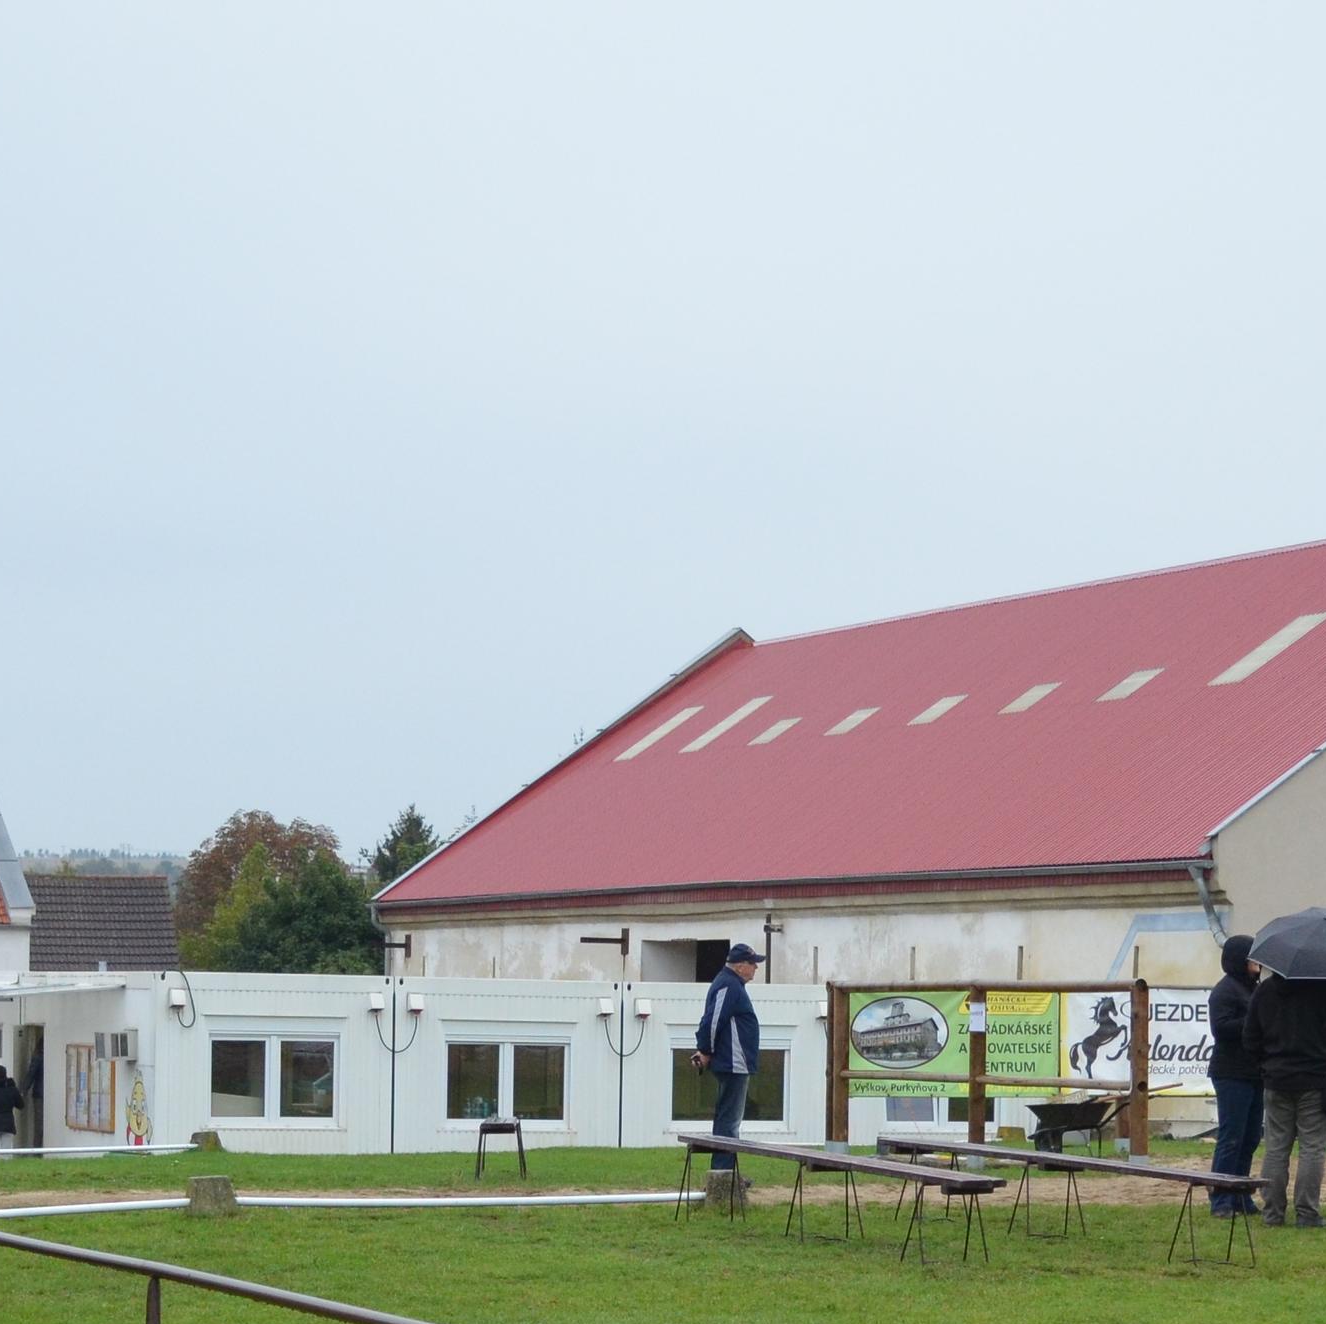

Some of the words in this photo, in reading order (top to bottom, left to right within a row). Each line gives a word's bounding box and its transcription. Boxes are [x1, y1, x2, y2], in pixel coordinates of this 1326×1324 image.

[1148, 1004, 1208, 1022] JEZDE
[958, 1021, 1052, 1035] ZRÁDKÁŘSKÉ
[958, 1043, 968, 1054] A
[988, 1040, 1052, 1054] OVATELSKÉ
[985, 1061, 1036, 1073] ENTRUM
[854, 1082, 890, 1094] Vyškov,
[890, 1083, 939, 1094] Purkyňova
[939, 1083, 946, 1093] 2
